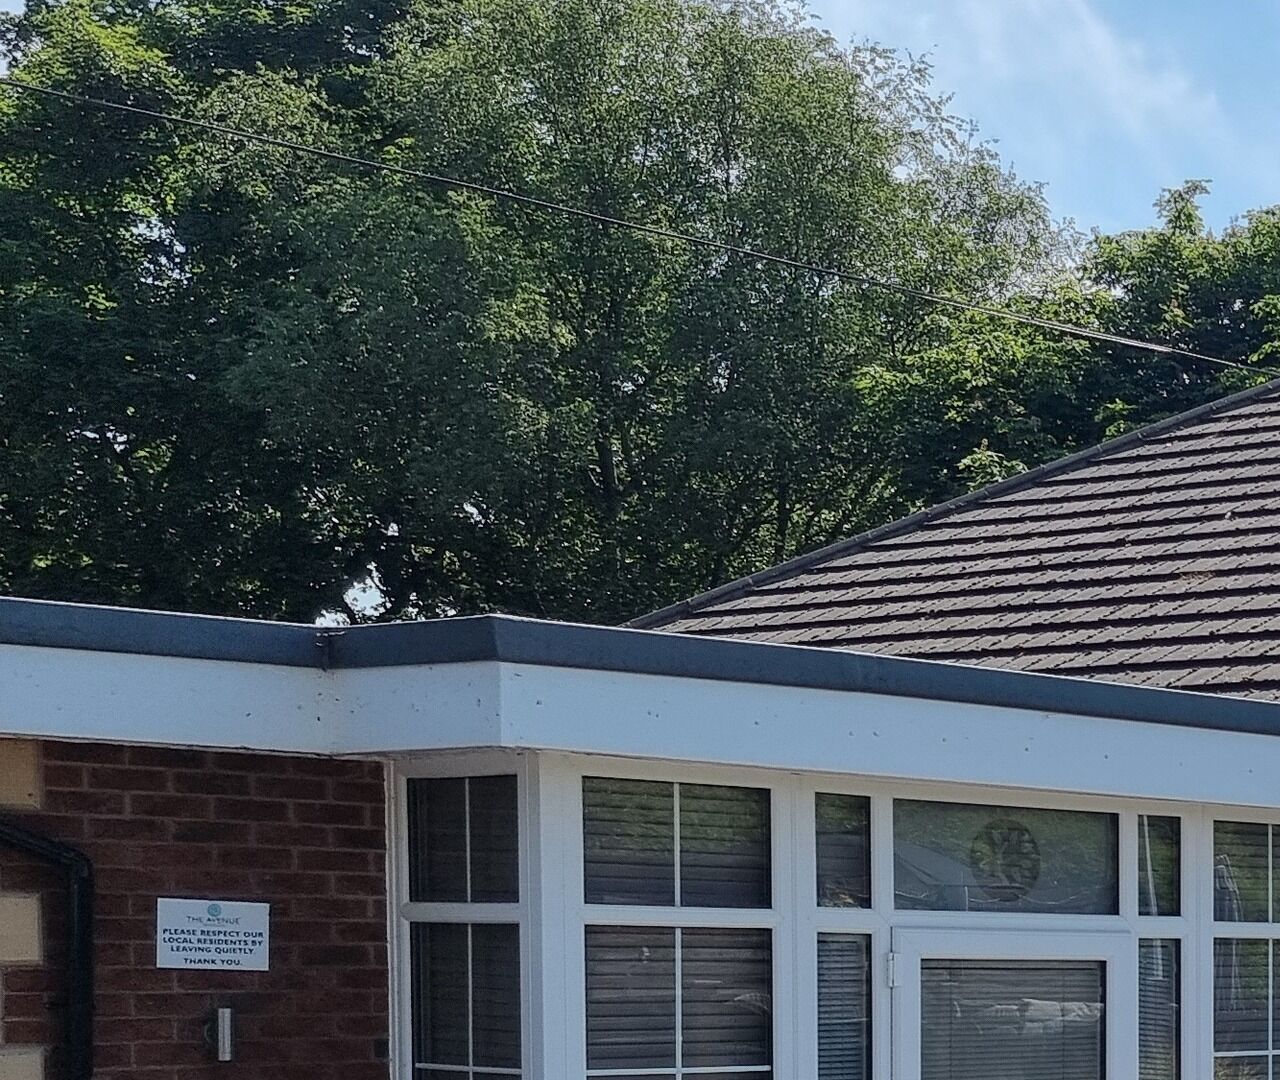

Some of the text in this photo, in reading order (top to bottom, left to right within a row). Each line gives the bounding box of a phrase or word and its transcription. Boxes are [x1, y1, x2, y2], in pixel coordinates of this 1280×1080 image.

[162, 928, 198, 936] PLEASE
[200, 929, 240, 938] RESPECT
[163, 936, 195, 944] LOCAL
[197, 938, 249, 946] RESIDENTS
[171, 945, 212, 953] LEAVING
[184, 957, 217, 965] THANK
